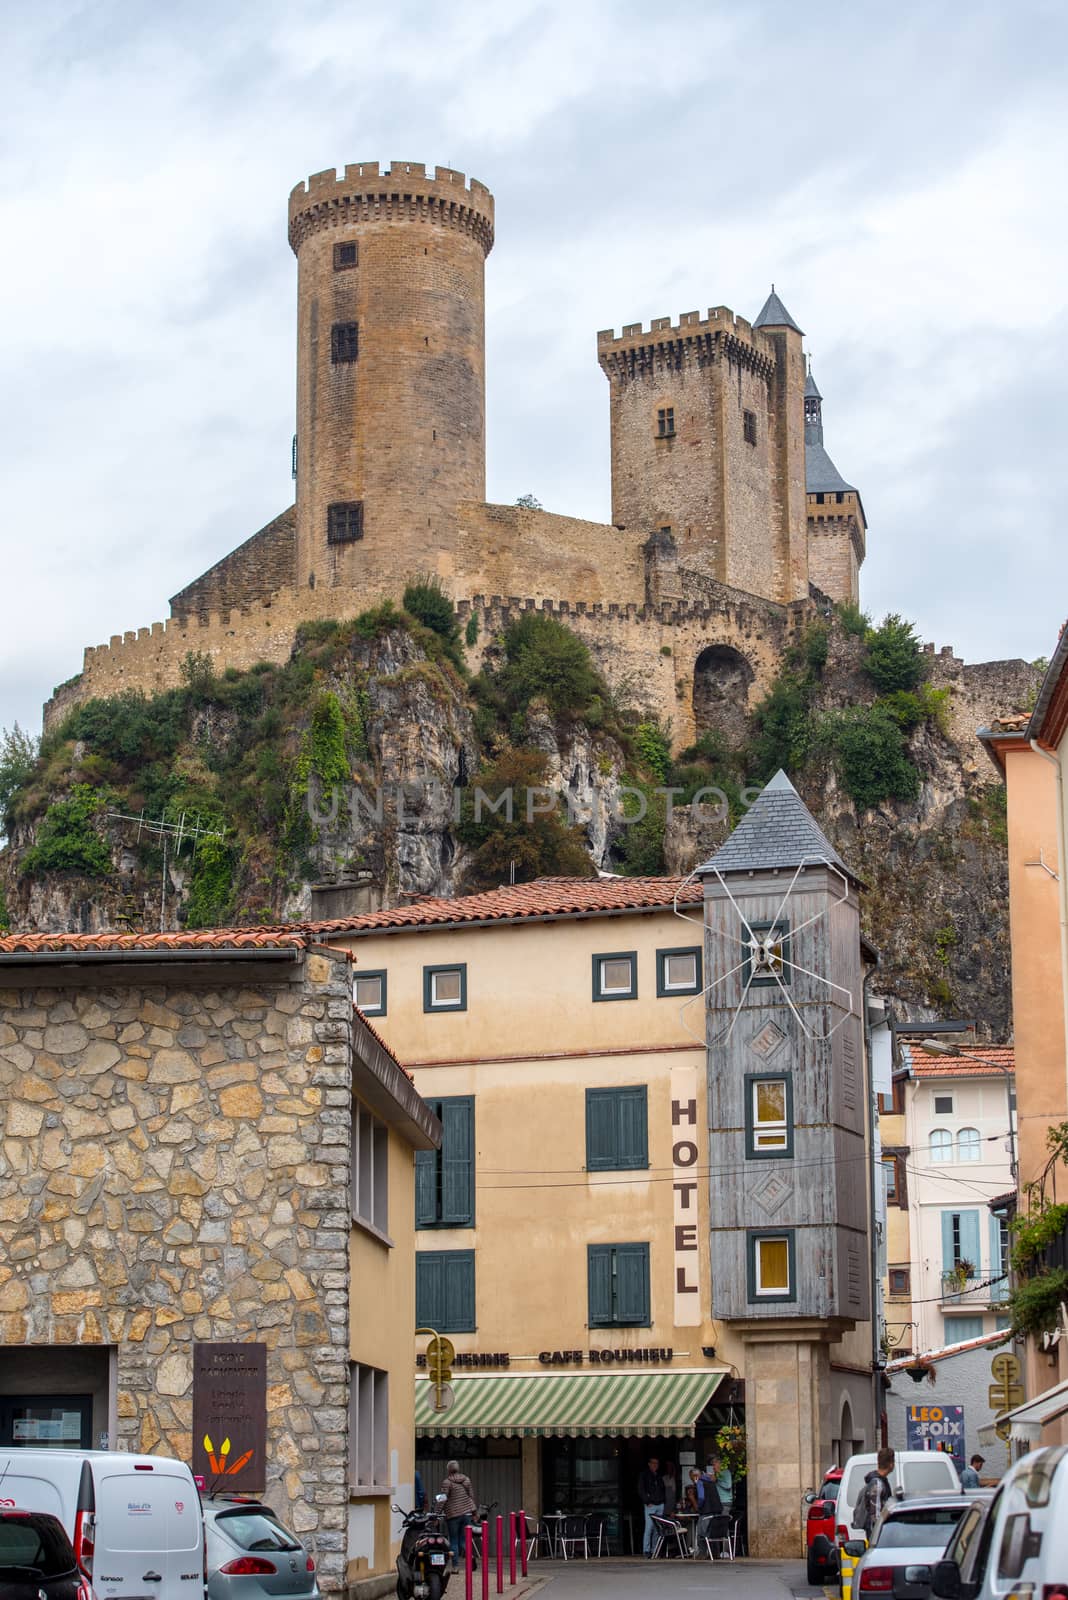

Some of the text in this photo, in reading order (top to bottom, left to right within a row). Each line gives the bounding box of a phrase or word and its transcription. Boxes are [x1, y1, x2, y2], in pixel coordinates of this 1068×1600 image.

[671, 1099, 698, 1293] HOTEL
[538, 1347, 673, 1364] CAFE ROUMIEU
